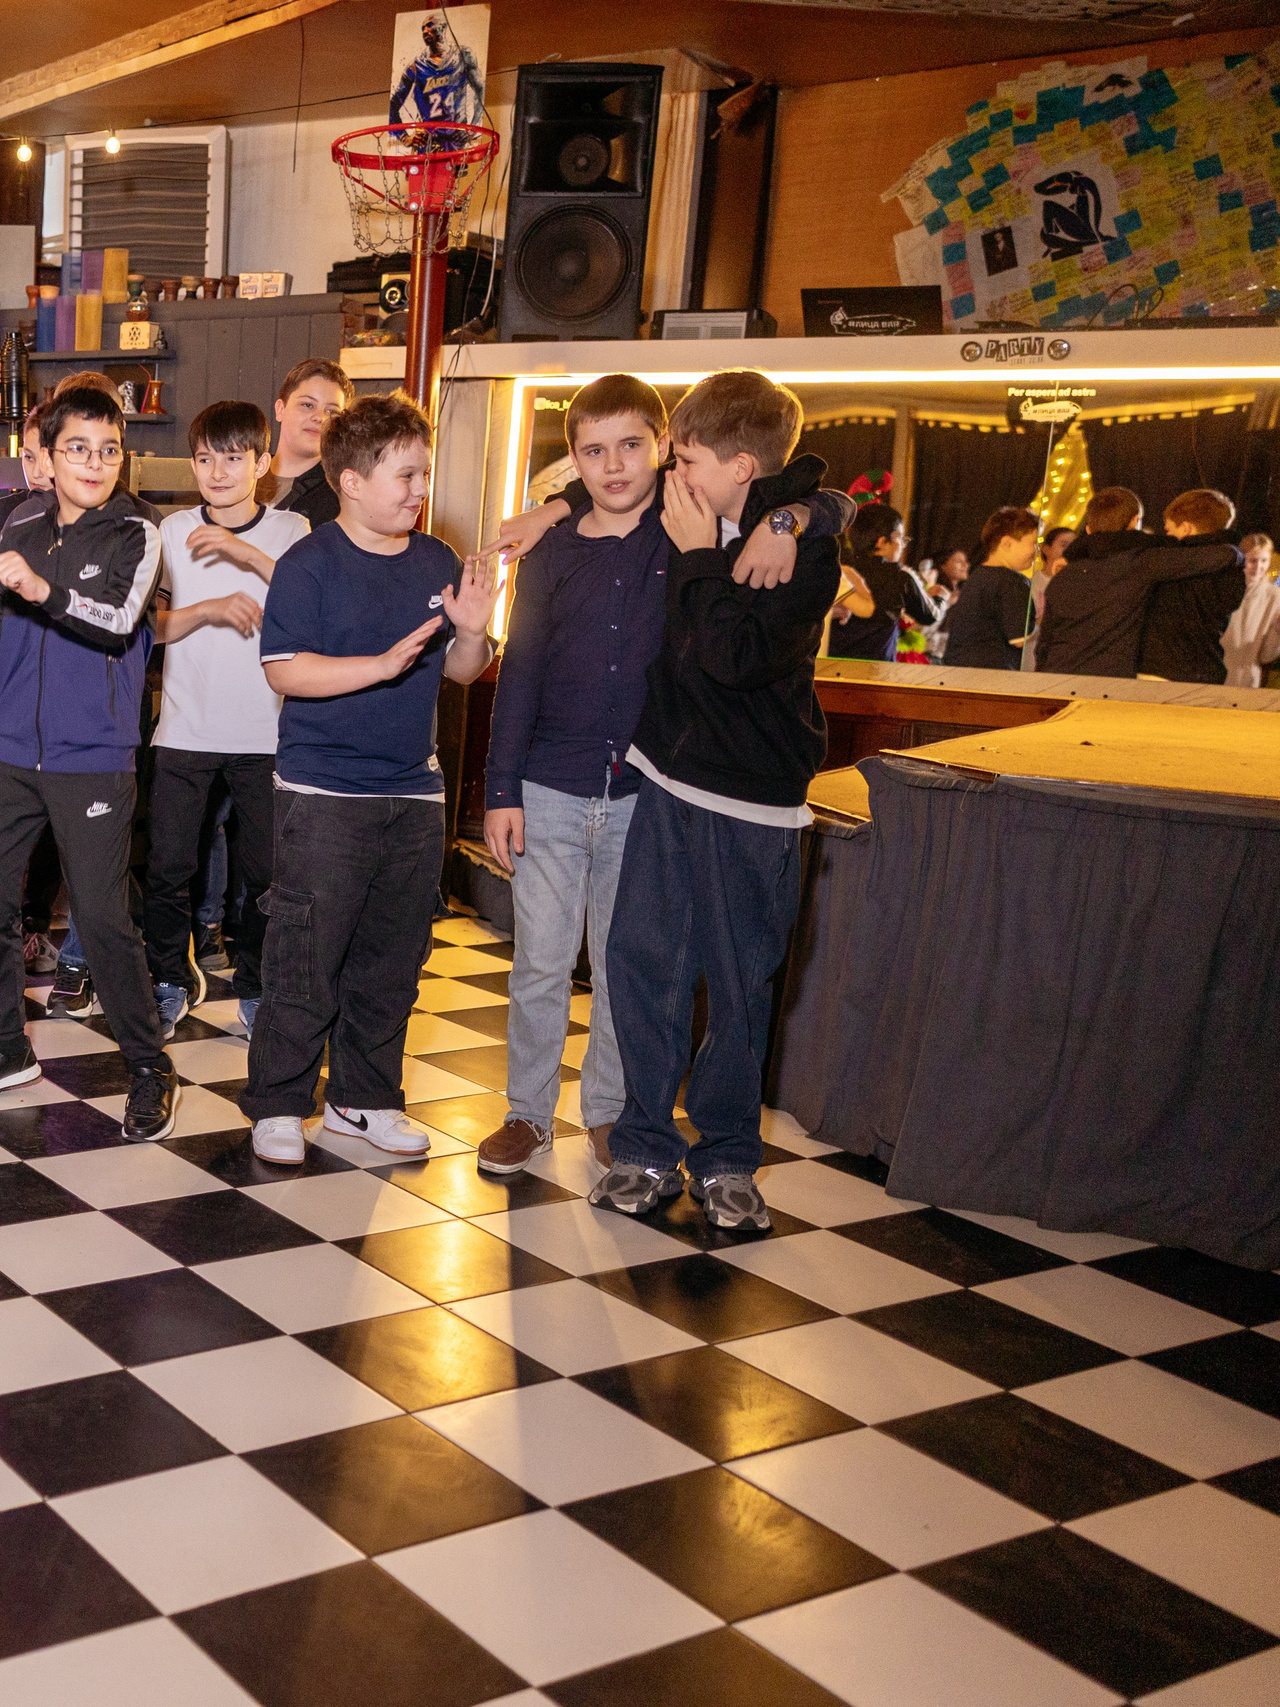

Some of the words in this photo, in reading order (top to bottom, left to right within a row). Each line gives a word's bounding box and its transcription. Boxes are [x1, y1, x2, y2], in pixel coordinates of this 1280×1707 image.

[985, 337, 1044, 362] PARTY
[1008, 387, 1025, 397] Per
[1025, 389, 1056, 398] aspera
[1058, 387, 1071, 397] ad
[1071, 388, 1096, 397] astra
[91, 801, 109, 812] NIKE
